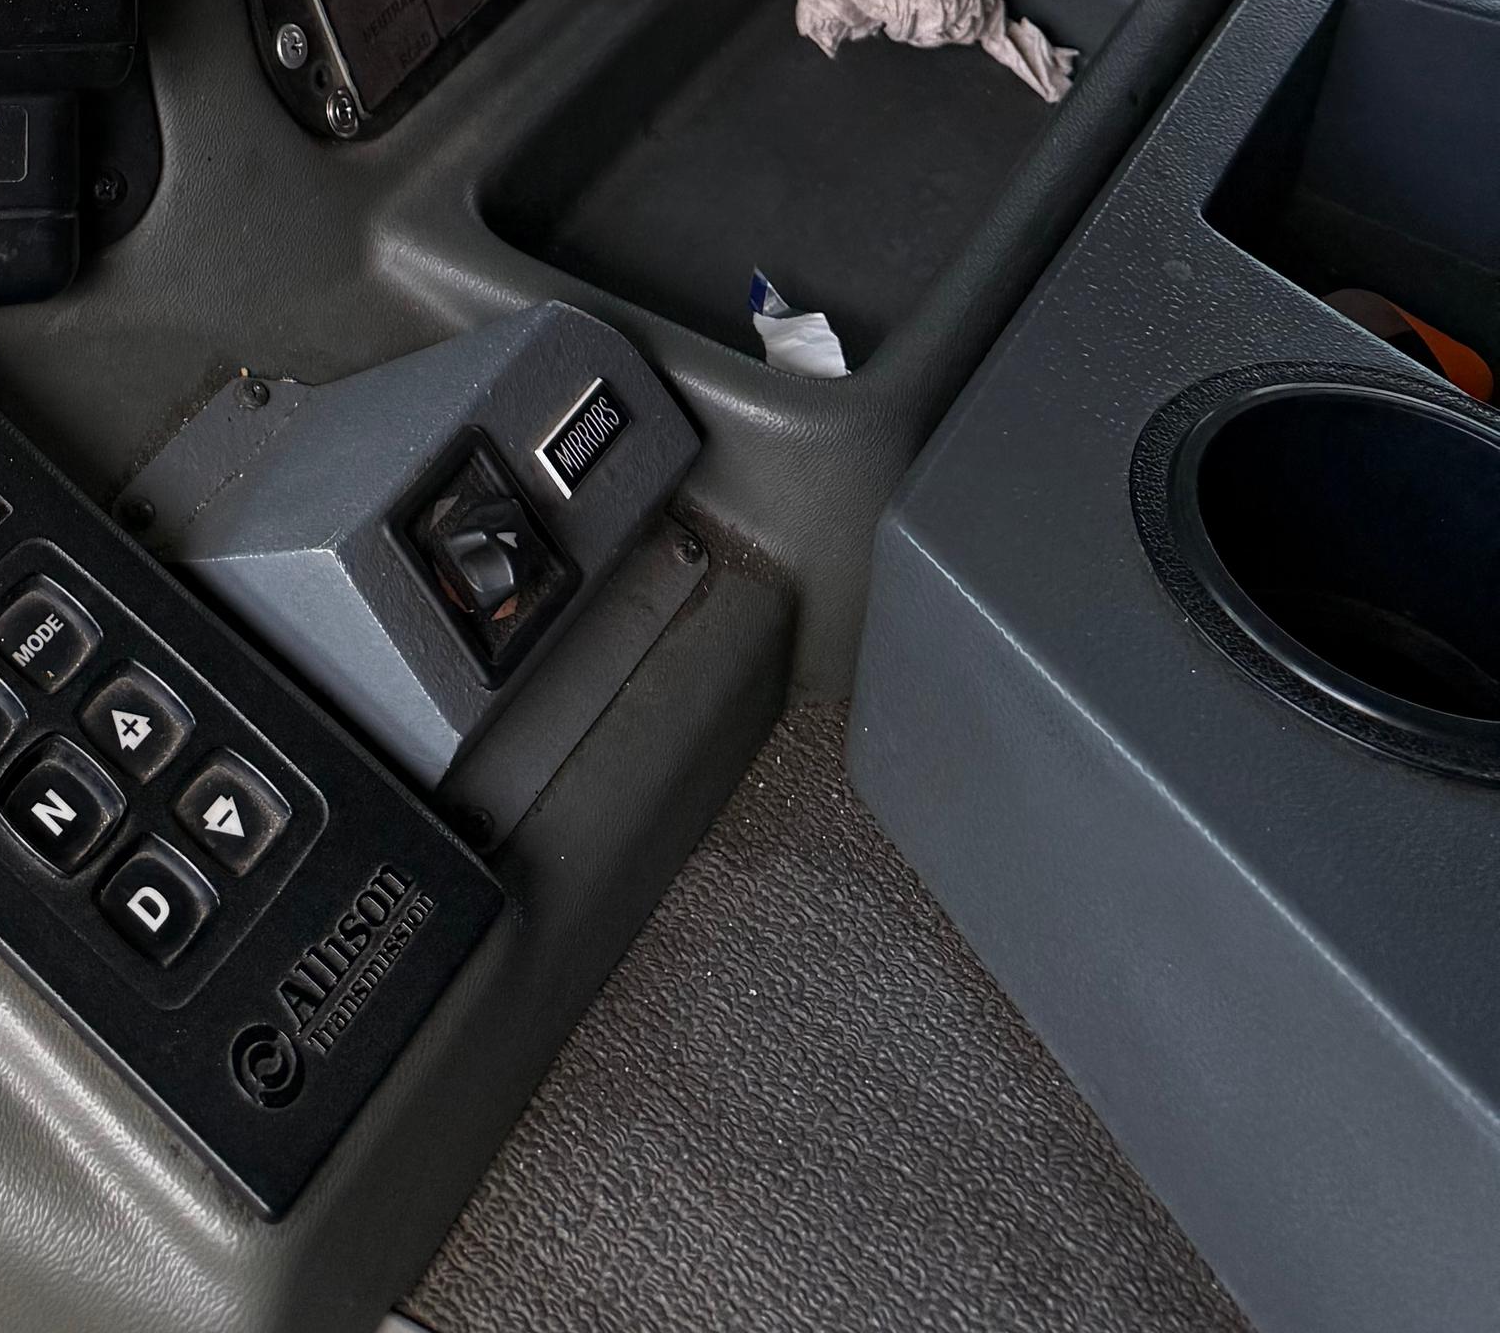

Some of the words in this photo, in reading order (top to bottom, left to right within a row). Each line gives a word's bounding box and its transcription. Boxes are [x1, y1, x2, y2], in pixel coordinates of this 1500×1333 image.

[554, 396, 620, 478] MIRRORS
[11, 612, 65, 668] MODE
[30, 787, 77, 837] N
[126, 885, 171, 933] D
[276, 864, 414, 1036] Allison
[306, 890, 438, 1056] Transmission
